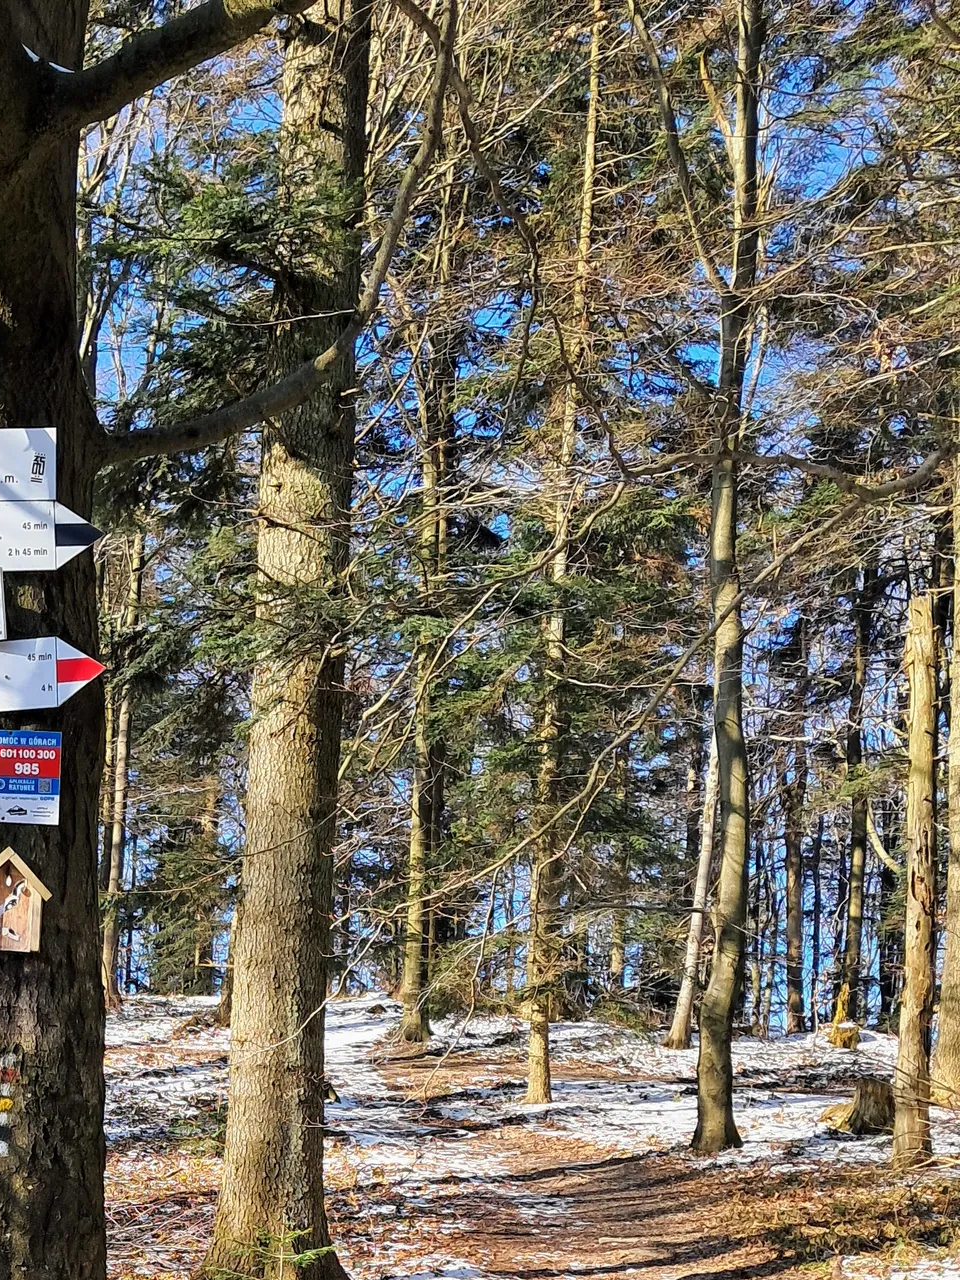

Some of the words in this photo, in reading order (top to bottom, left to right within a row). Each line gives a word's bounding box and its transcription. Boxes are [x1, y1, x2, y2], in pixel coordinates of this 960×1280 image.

[22, 521, 32, 530] 45
[33, 521, 48, 530] min
[7, 548, 13, 557] 2
[14, 547, 20, 556] h
[22, 547, 32, 556] 45
[33, 547, 48, 556] min
[27, 653, 36, 662] 45
[38, 652, 52, 662] min
[41, 683, 46, 692] 4
[47, 683, 53, 692] h
[20, 737, 27, 745] W
[28, 735, 57, 746] GÓRACH
[0, 748, 17, 758] 601
[18, 749, 36, 759] 100
[36, 750, 56, 760] 300
[14, 762, 40, 775] 985
[8, 784, 35, 792] RATUNEK
